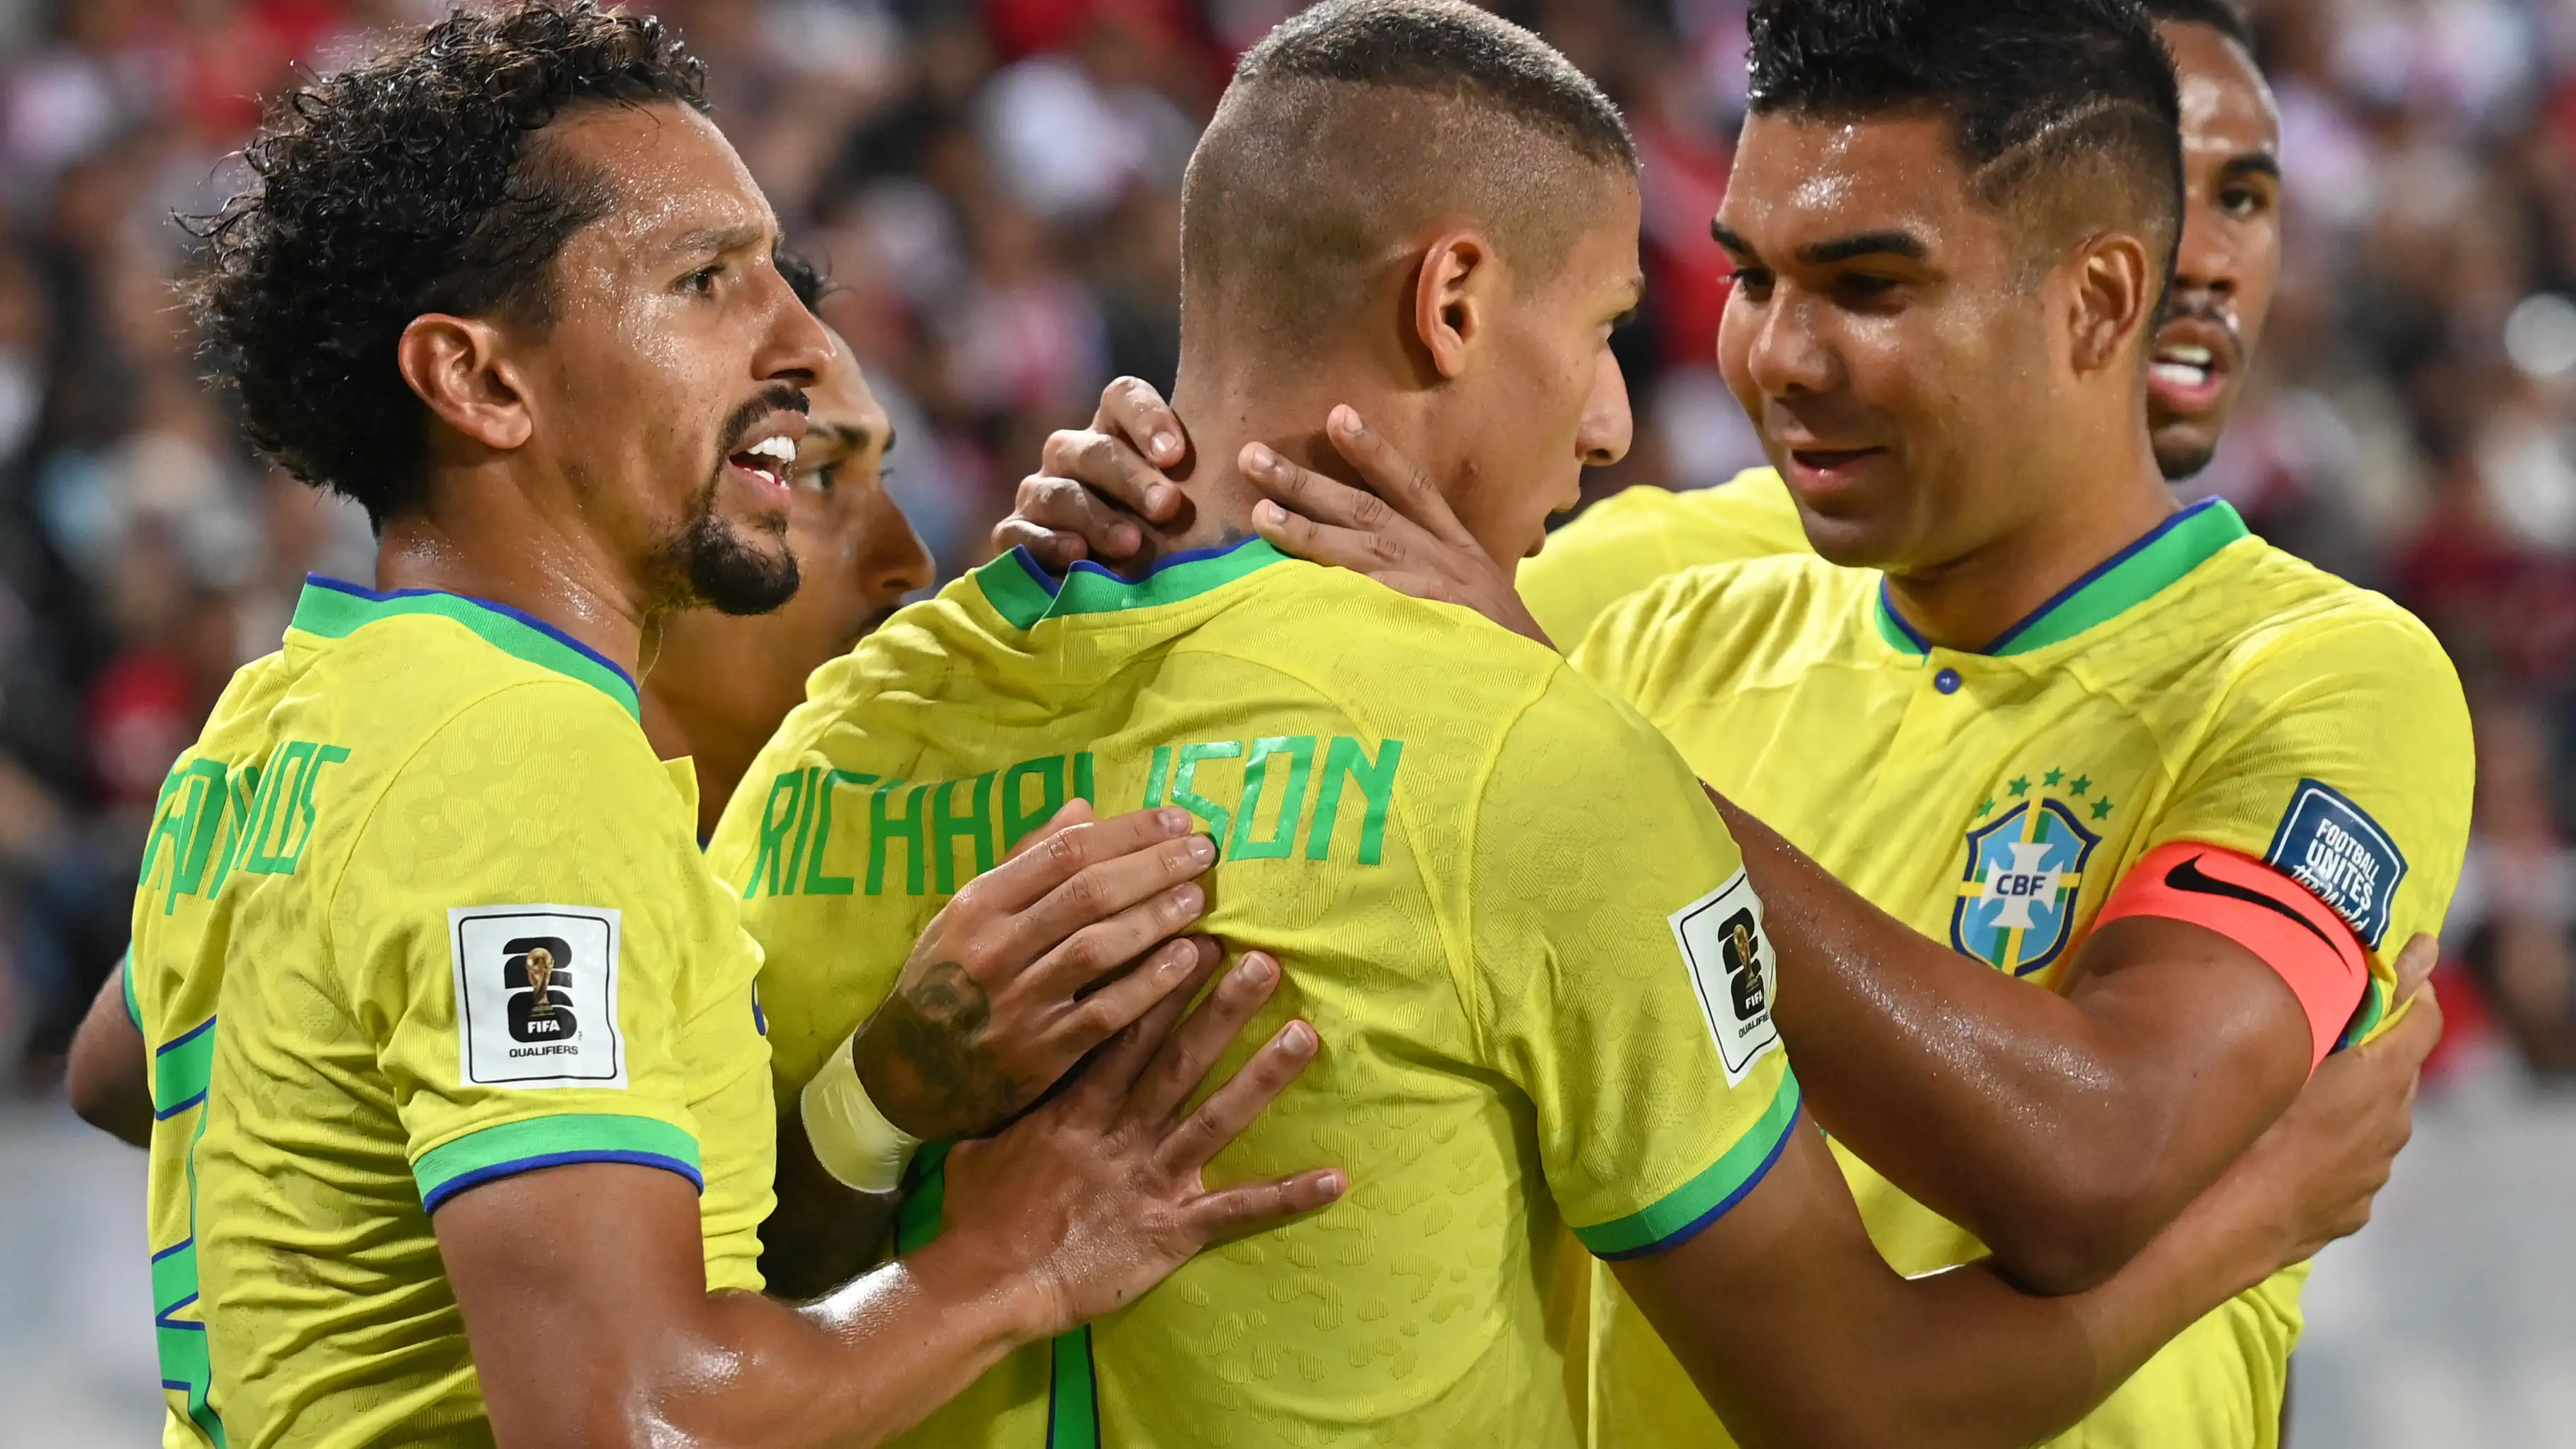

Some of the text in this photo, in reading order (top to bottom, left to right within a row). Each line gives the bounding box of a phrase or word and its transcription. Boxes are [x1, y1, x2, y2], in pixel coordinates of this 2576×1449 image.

[2316, 818, 2380, 887] FOOTBALL
[1996, 874, 2047, 897] CBF
[2305, 839, 2373, 911] UNITES
[527, 1019, 561, 1034] FIFA
[1738, 1012, 1770, 1039] QUALIFIE
[508, 1044, 579, 1059] QUALIFIERS
